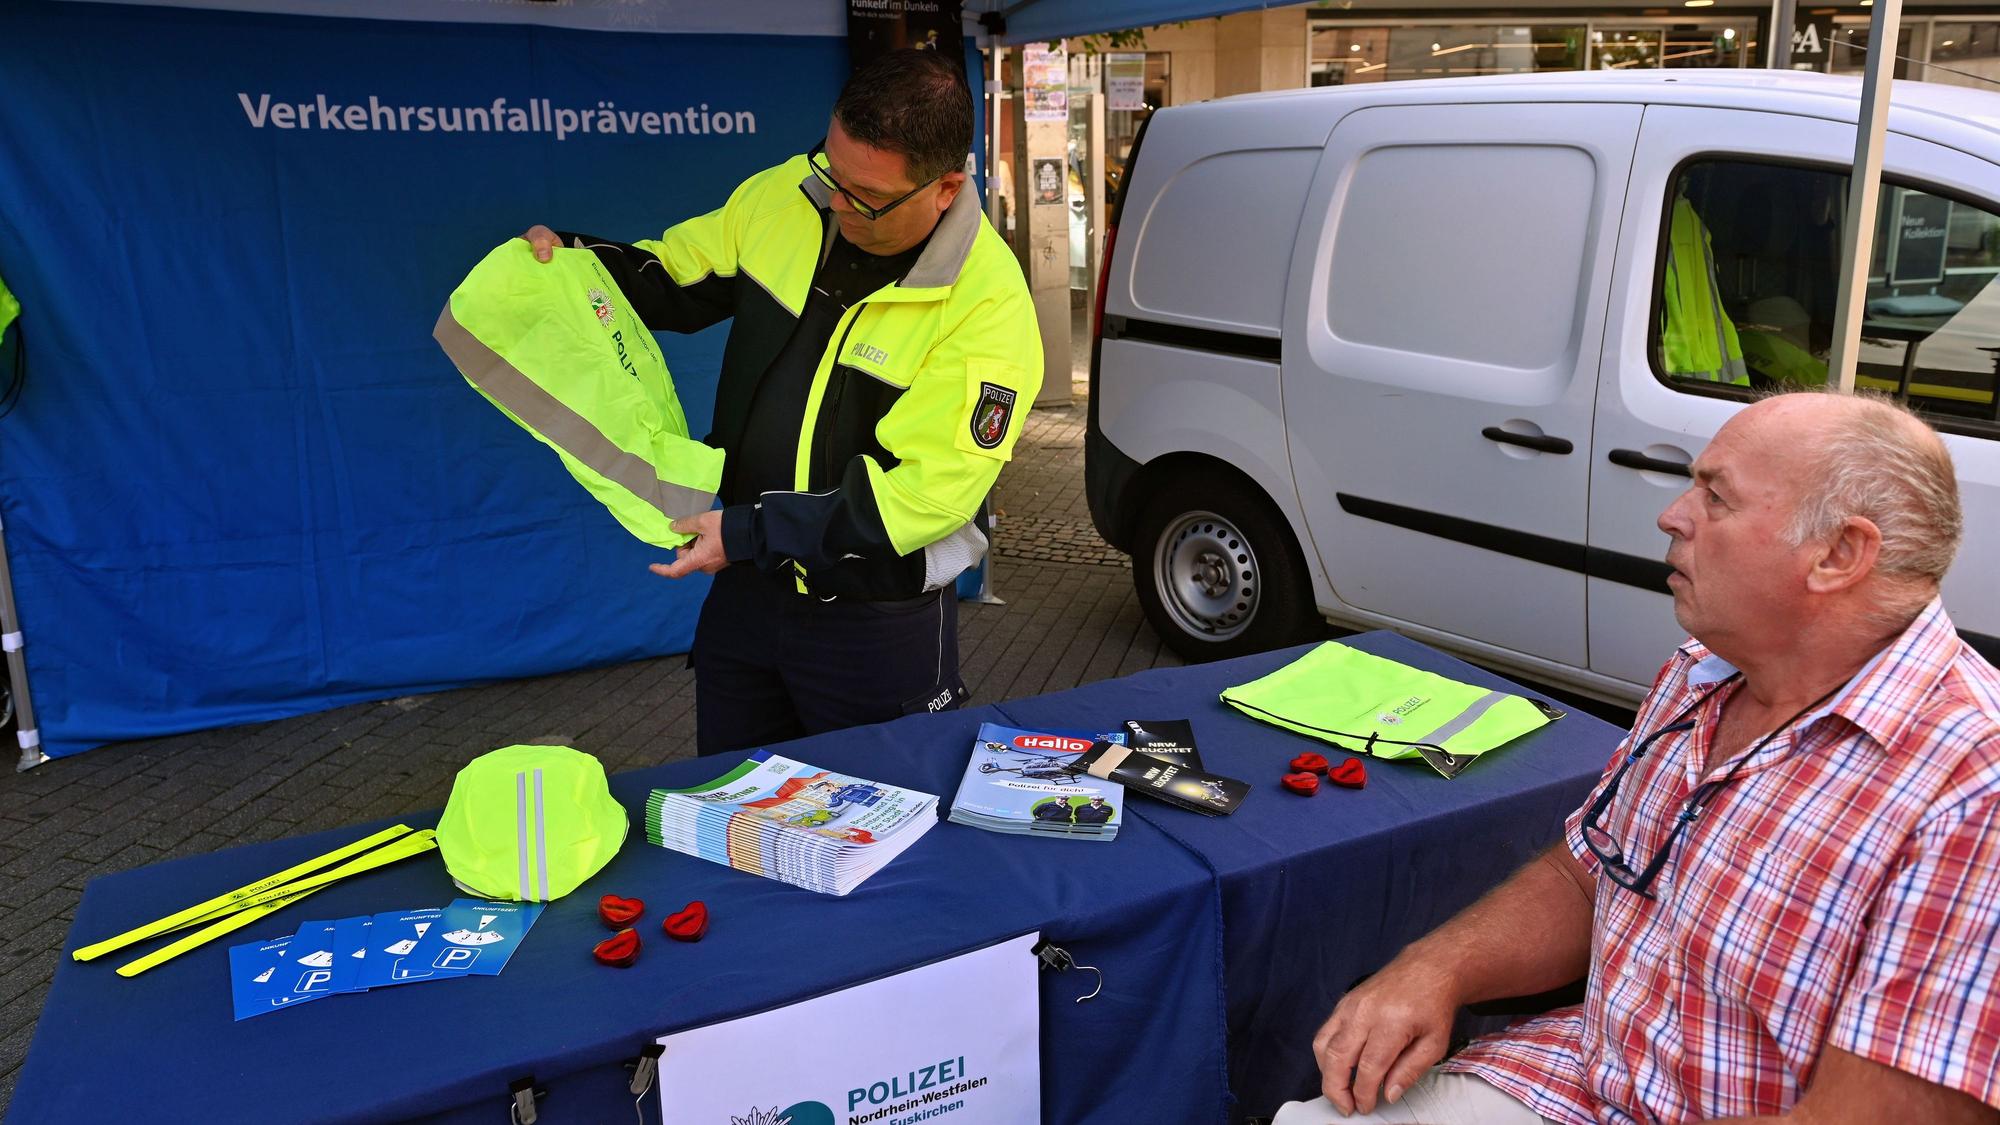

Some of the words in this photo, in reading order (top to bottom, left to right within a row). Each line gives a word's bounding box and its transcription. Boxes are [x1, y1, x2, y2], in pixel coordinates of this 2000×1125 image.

[890, 1, 901, 11] im
[904, 1, 939, 12] Dunkeln
[1791, 23, 1823, 53] &A
[237, 92, 757, 140] Verkehrsunfallprävention
[612, 330, 641, 382] POLIZ
[927, 688, 953, 714] POLIZE
[1393, 696, 1421, 715] POLIZEI
[1024, 737, 1084, 751] Hallo
[1142, 766, 1161, 781] NRW
[1151, 765, 1179, 788] LEUCHTET
[1008, 782, 1040, 790] Polizei
[850, 812, 874, 825] Bruno
[873, 801, 888, 813] und
[885, 790, 902, 802] Lisa
[861, 803, 898, 827] unterwegs
[871, 822, 884, 831] der
[882, 810, 904, 823] Stadt
[249, 879, 280, 893] POLIZEI
[258, 889, 290, 902] POLIZEI
[441, 949, 472, 967] P
[847, 1055, 966, 1113] POLIZEI
[848, 1075, 988, 1125] Nordrhein-Westfalen
